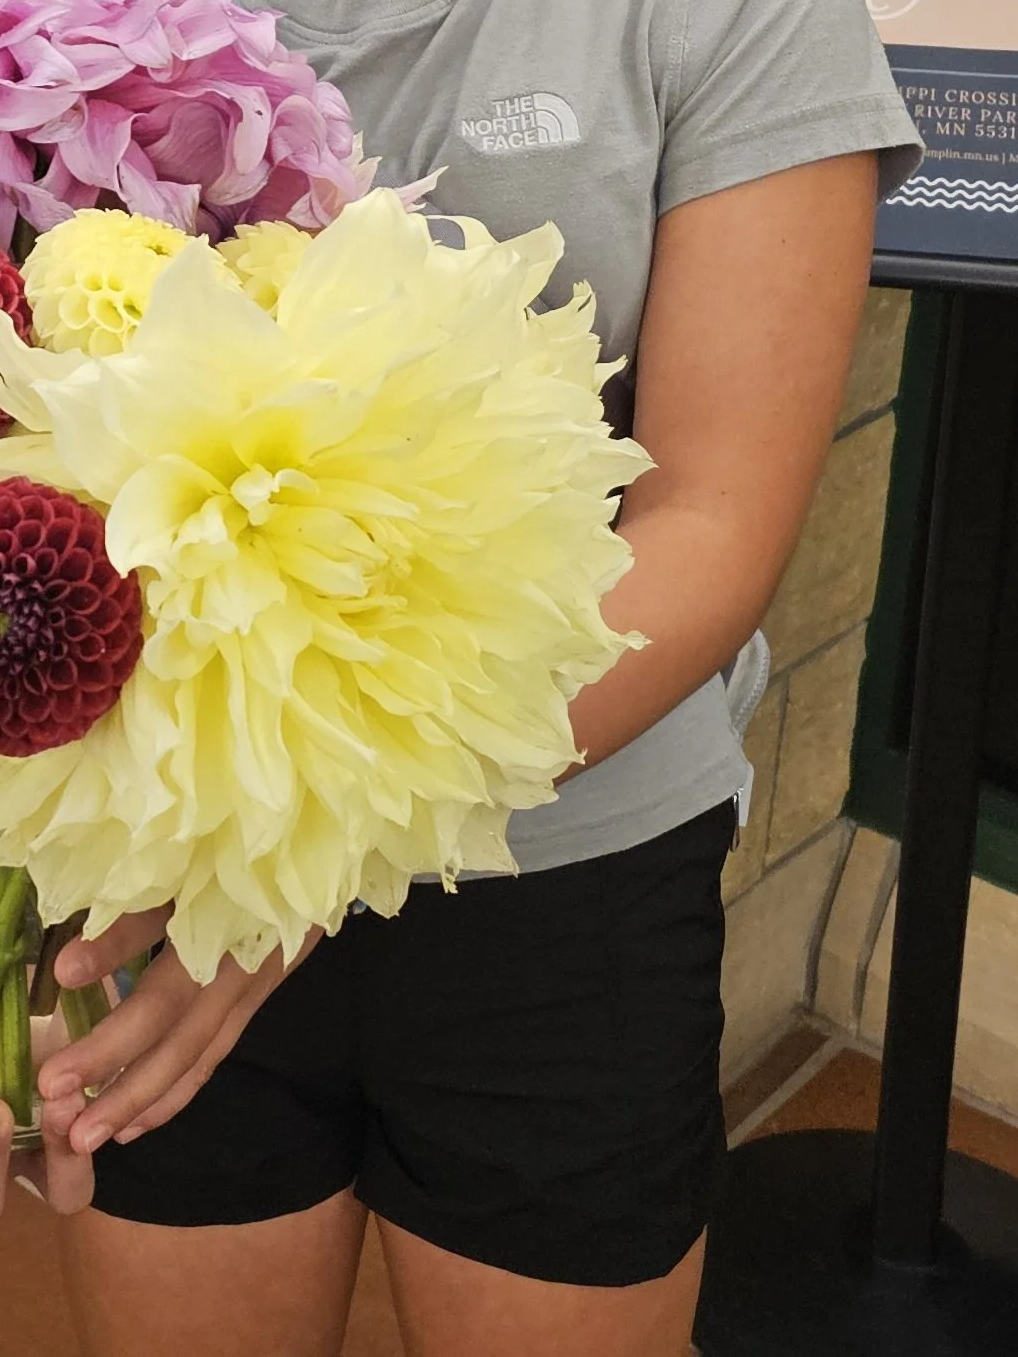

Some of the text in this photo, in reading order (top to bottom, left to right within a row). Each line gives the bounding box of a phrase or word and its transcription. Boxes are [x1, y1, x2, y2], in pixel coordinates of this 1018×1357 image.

[492, 95, 534, 117] THE
[944, 89, 1018, 107] CROSSI
[461, 112, 536, 137] NORTH
[914, 104, 1018, 124] RIVER PAR
[482, 128, 538, 151] FACE
[936, 121, 966, 136] MN
[974, 124, 1018, 140] 5531
